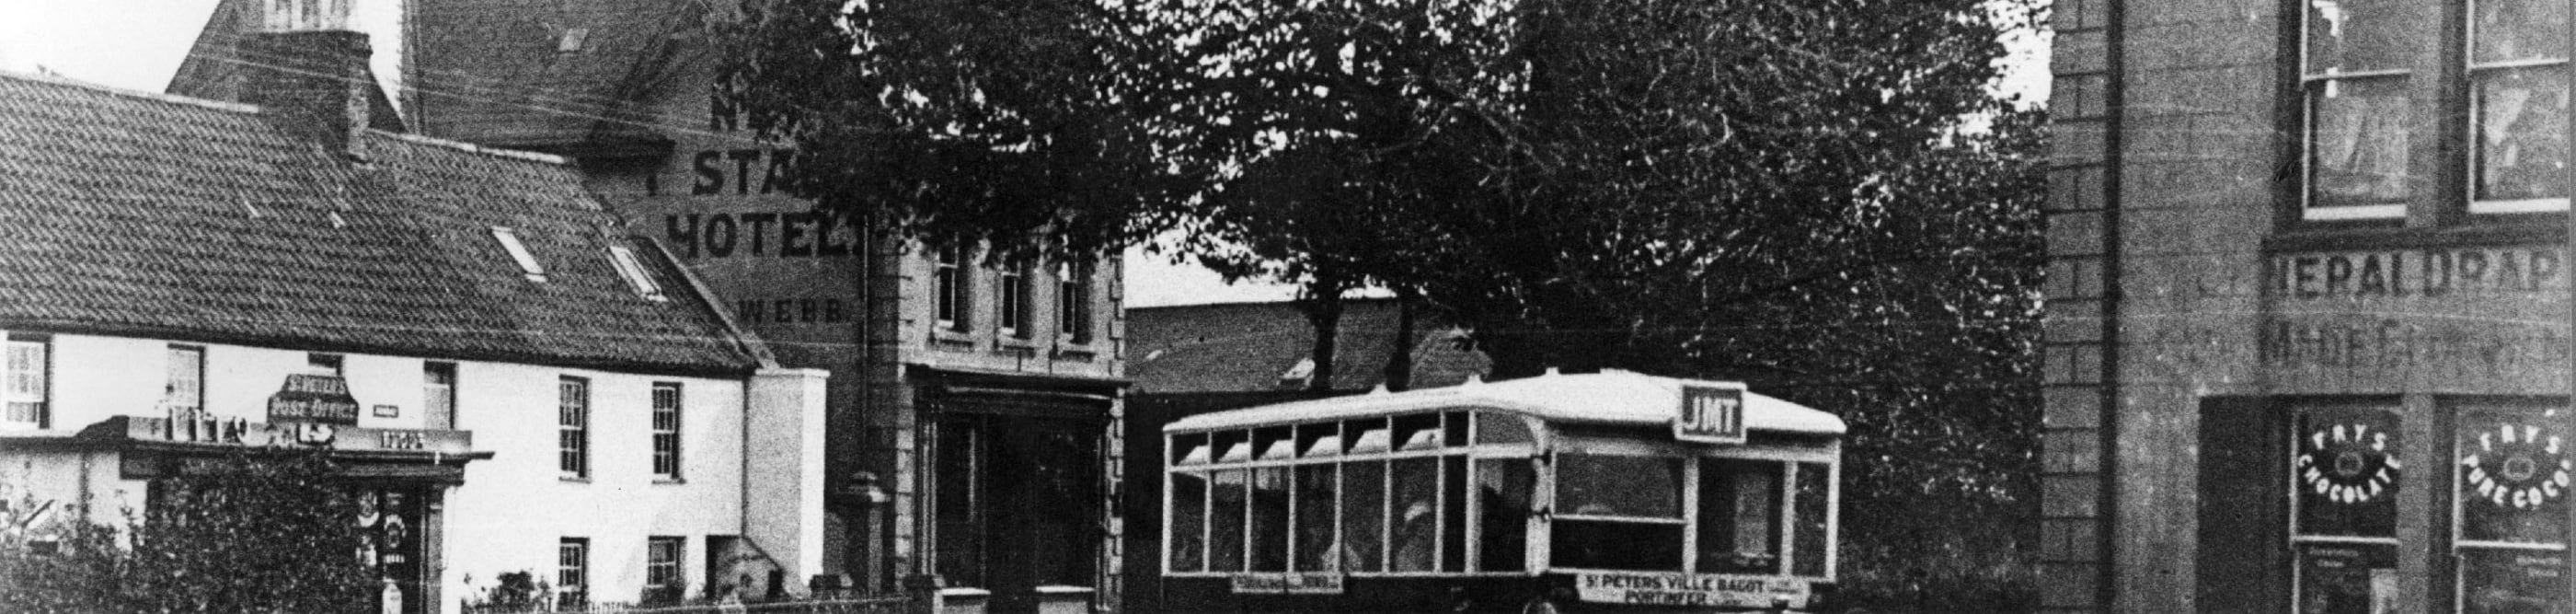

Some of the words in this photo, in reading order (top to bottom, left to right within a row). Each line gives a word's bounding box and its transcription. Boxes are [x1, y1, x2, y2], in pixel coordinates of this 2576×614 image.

[666, 212, 861, 259] HOTEL
[270, 397, 307, 416] POST
[311, 399, 357, 419] OFFICE
[1683, 395, 1739, 434] JMT
[2298, 454, 2402, 504] CHOCOLATE
[2462, 454, 2508, 505] PURE
[1717, 577, 1765, 594] BAGOT
